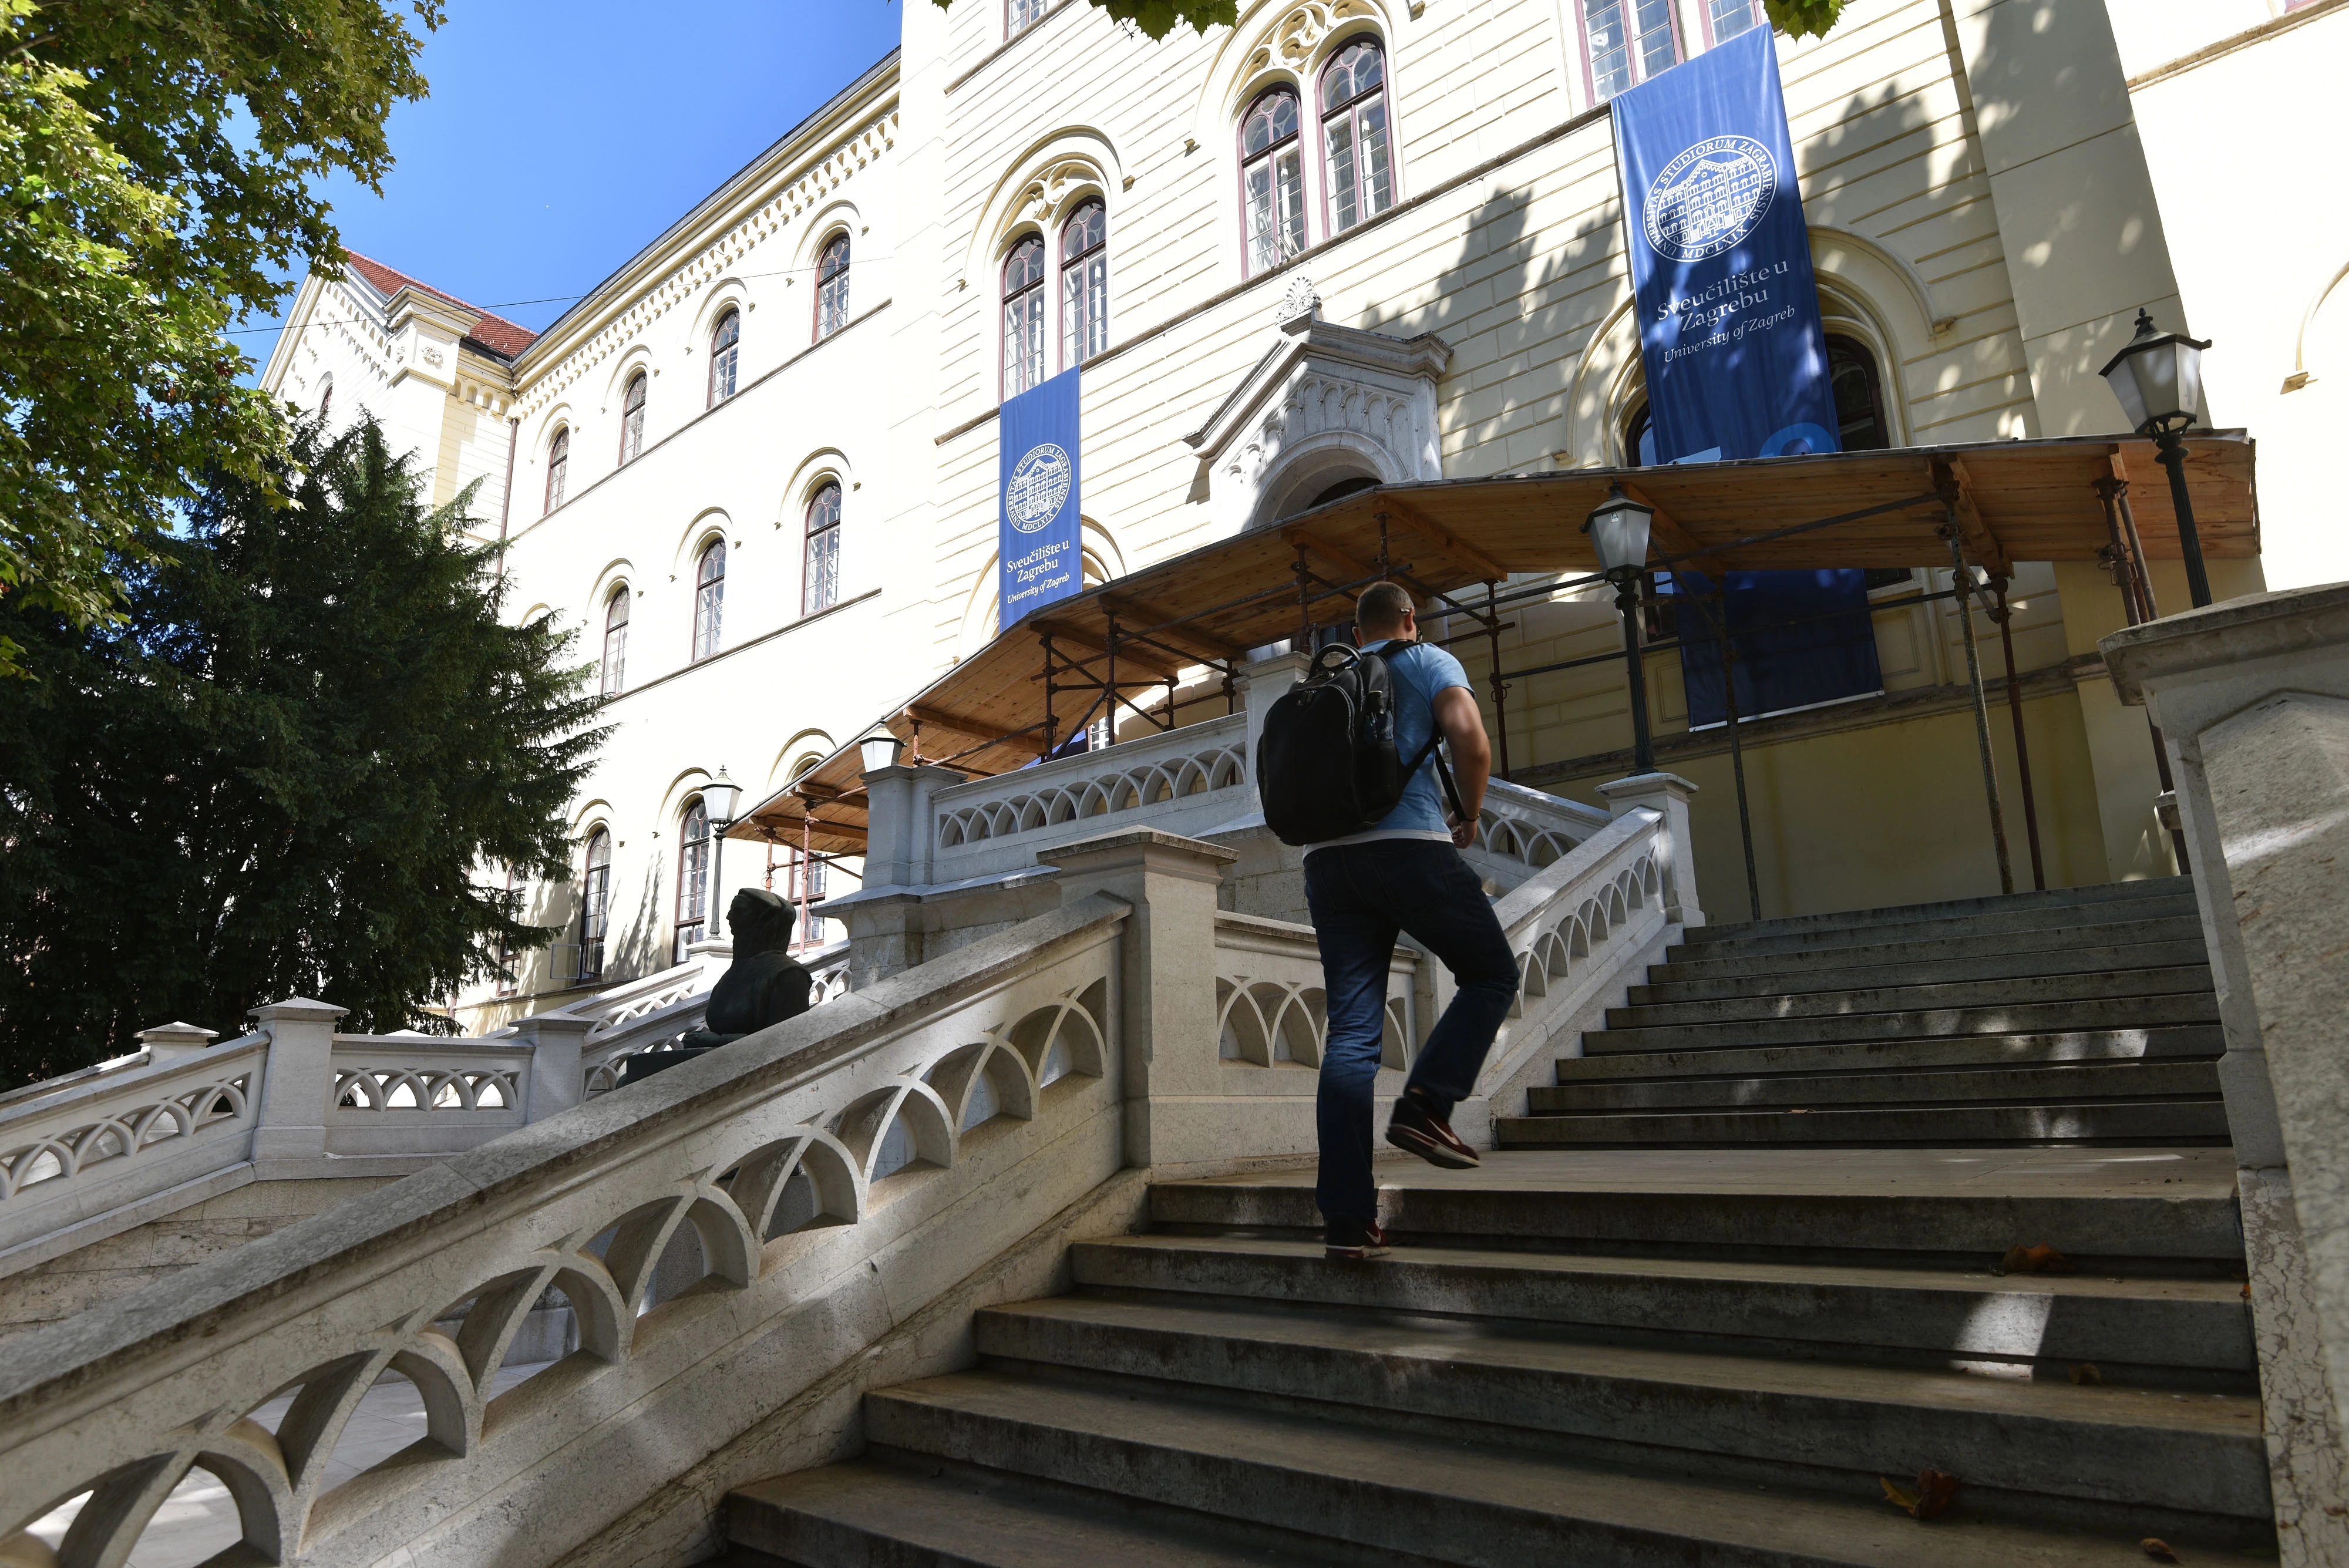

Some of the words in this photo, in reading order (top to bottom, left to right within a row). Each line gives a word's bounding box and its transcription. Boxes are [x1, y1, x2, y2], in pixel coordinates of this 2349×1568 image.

[1660, 139, 1737, 184] STUDIORUM
[1738, 140, 1772, 221] ZAGRABIENSIS
[1646, 187, 1677, 256] UNIVERSITAS
[1681, 224, 1748, 258] MDCLXIX
[1657, 268, 1770, 321] Sveučilište
[1773, 260, 1789, 275] u
[1681, 289, 1769, 332] Zagrebu
[1664, 331, 1729, 362] University
[1733, 321, 1748, 340] of
[1748, 305, 1795, 332] Zagreb
[1008, 475, 1021, 527] UNIVERSITAS
[1017, 446, 1055, 473] STUDIORUM
[1055, 449, 1069, 509] ZAGRABIENSIS
[1021, 510, 1054, 530] MDCLXIX
[1007, 543, 1061, 573] Sveučilište
[1062, 540, 1069, 550] u
[1017, 558, 1058, 583] Zagrebu
[1007, 586, 1038, 604] University
[1039, 579, 1047, 593] of
[1046, 572, 1069, 588] Zagreb
